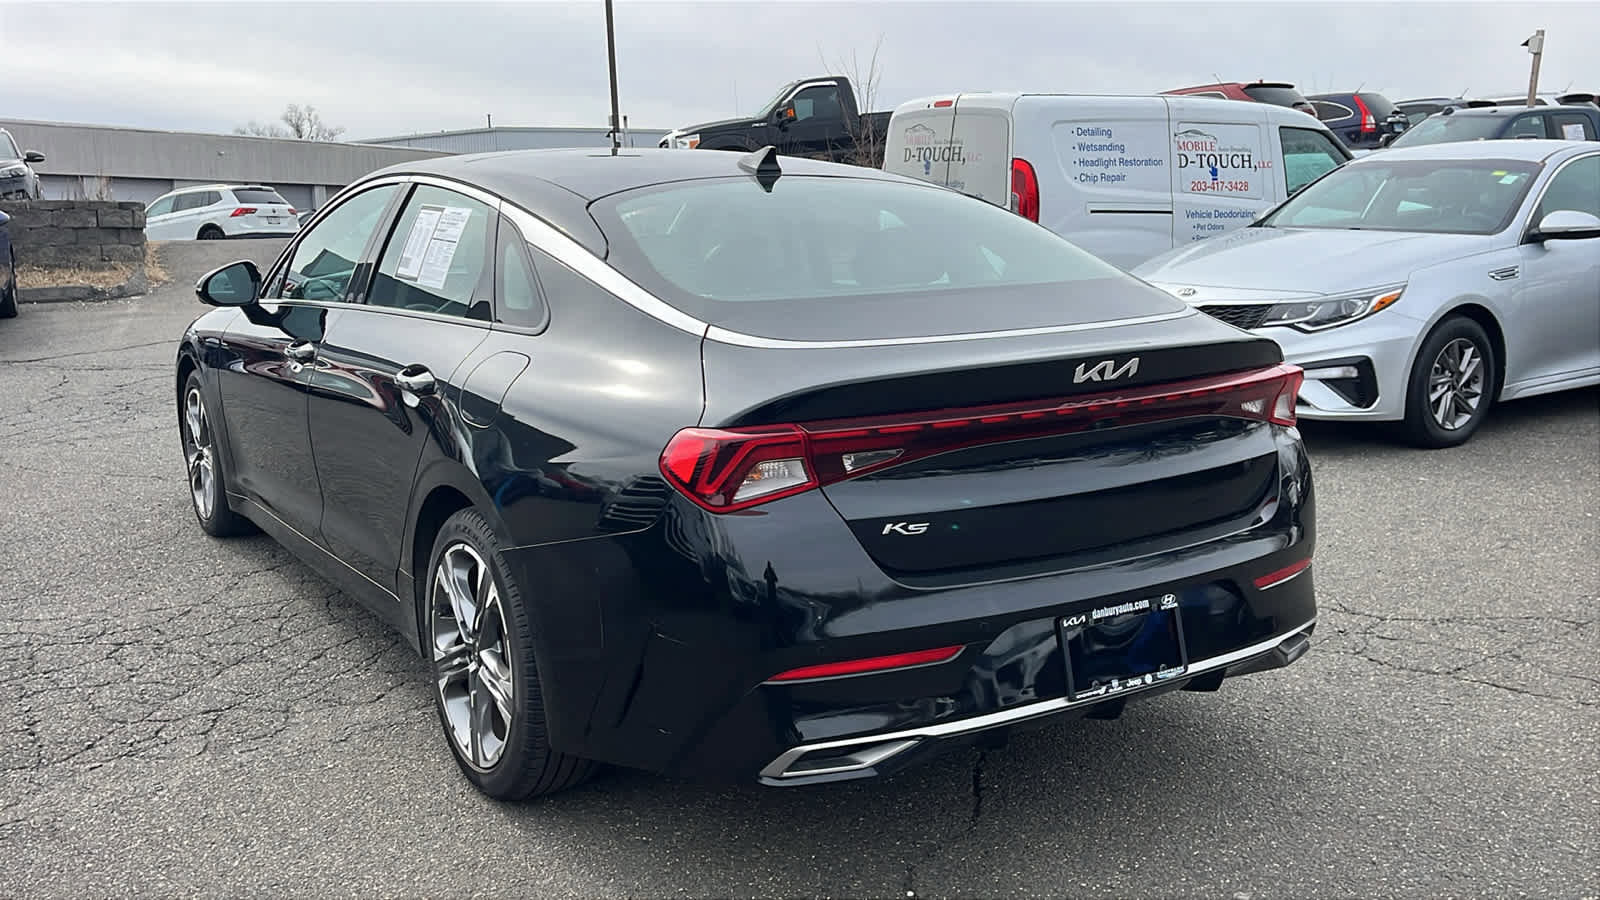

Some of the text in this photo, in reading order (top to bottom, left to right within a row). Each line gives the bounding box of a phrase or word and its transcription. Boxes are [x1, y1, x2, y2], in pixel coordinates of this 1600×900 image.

[1076, 127, 1112, 138] Detailing
[1078, 143, 1125, 153] Wetsanding
[1176, 140, 1216, 152] MOBILE
[904, 146, 966, 165] D-TOUCH,
[1079, 158, 1164, 169] Headlight Restoration
[1177, 153, 1273, 172] D-TOUCH, LLC
[1079, 173, 1126, 184] Chip Repair
[1191, 180, 1249, 192] 203-417-3428
[1185, 209, 1212, 219] Vehicle
[1196, 223, 1225, 231] Pet Odors
[1073, 357, 1140, 384] KIA
[882, 522, 930, 535] K5
[1063, 615, 1086, 627] KIA
[1092, 599, 1149, 619] danburyauto.com
[1126, 678, 1142, 687] Jeep
